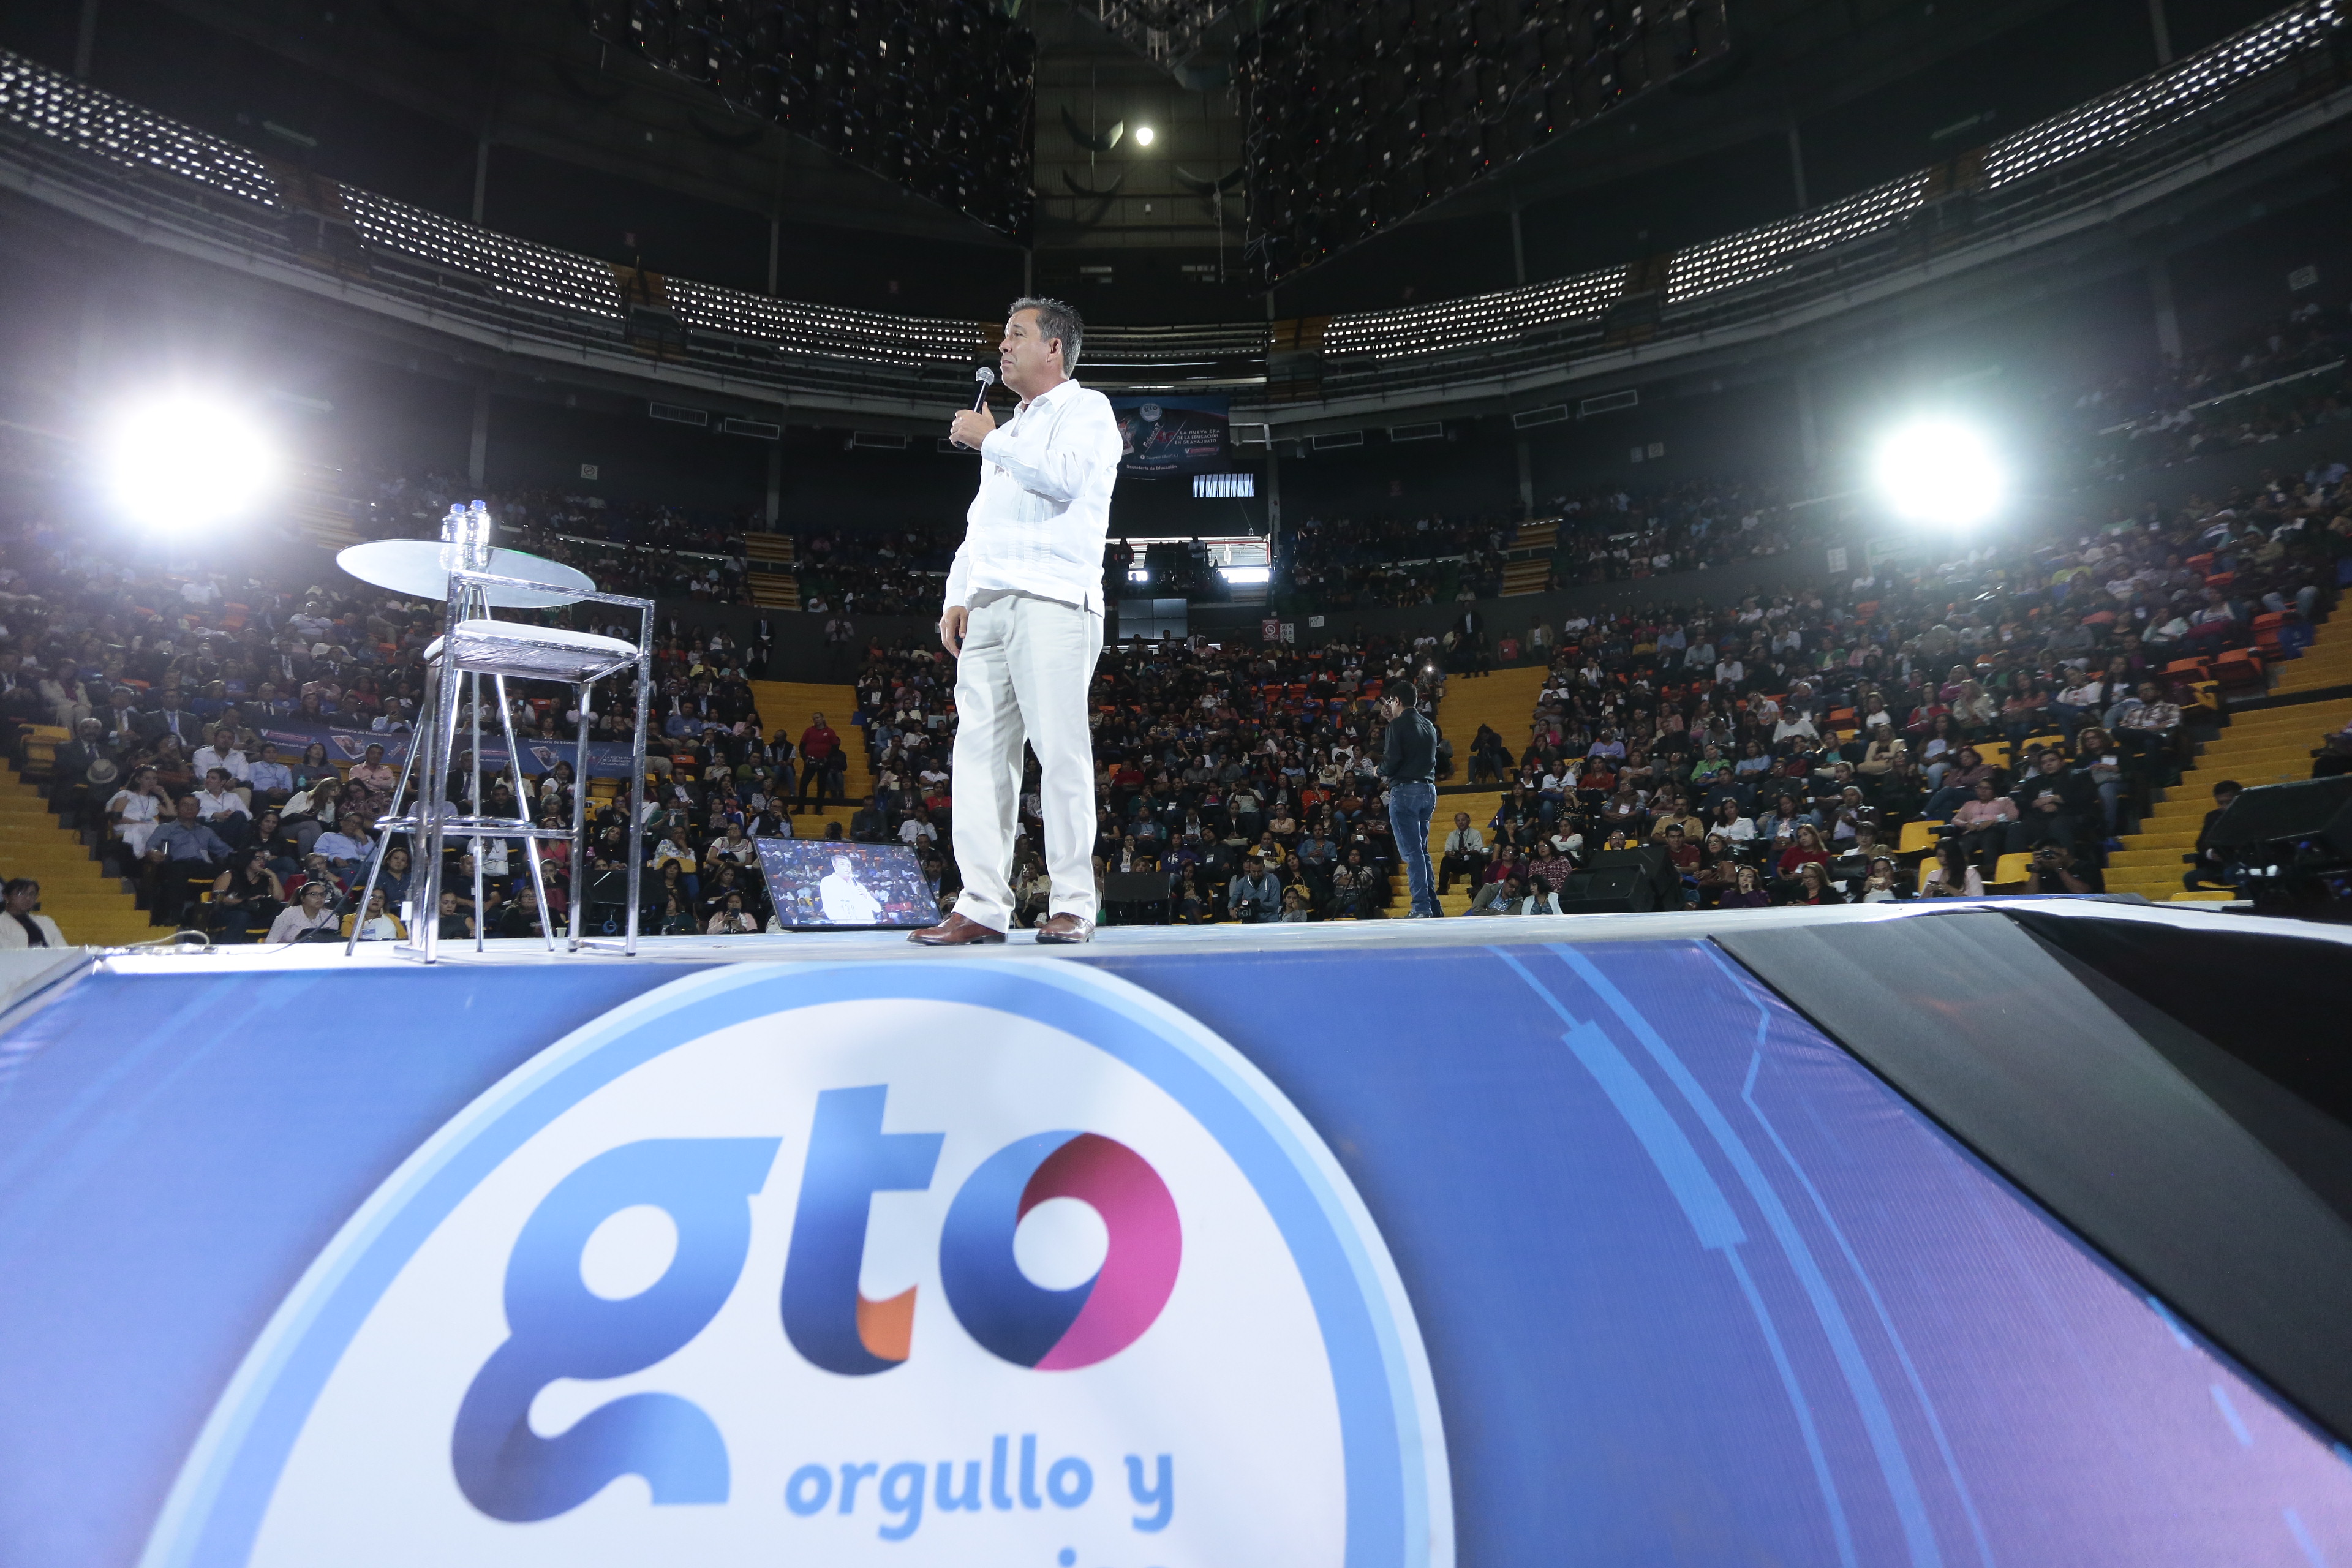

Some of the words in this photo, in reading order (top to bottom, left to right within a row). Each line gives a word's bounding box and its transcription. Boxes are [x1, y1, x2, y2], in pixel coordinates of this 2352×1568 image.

[451, 1084, 1183, 1523] gto
[785, 1434, 1094, 1542] orgullo
[1123, 1452, 1175, 1534] y
